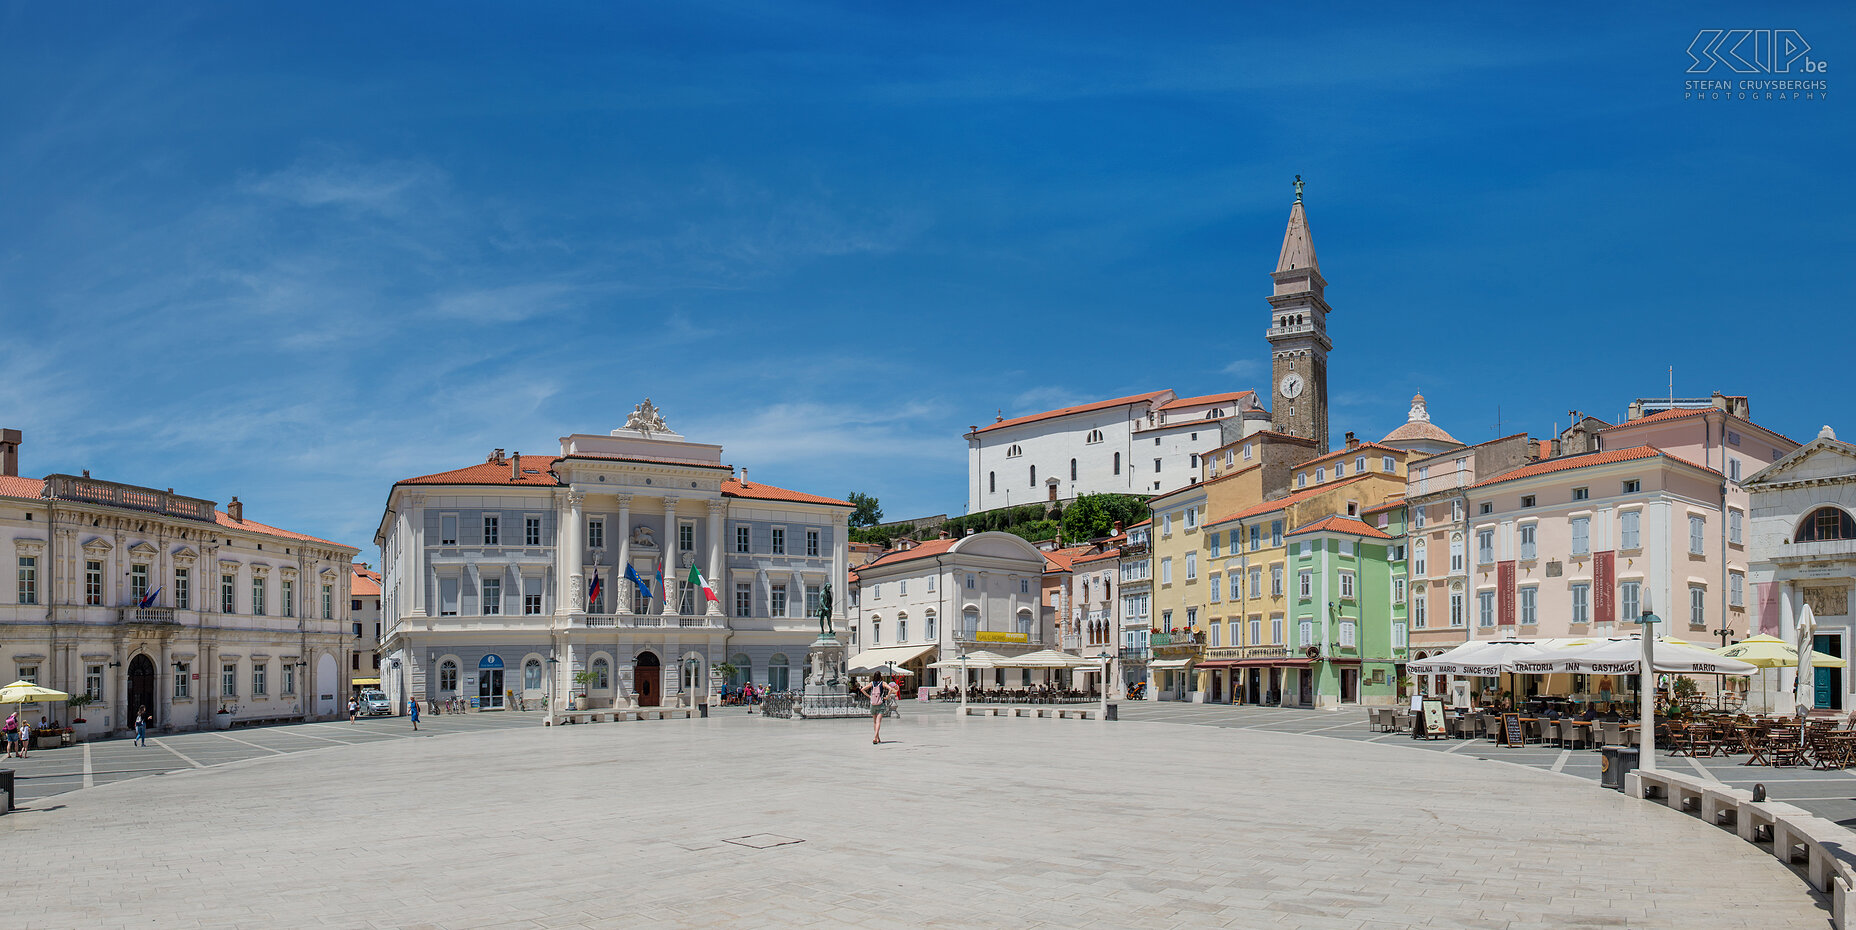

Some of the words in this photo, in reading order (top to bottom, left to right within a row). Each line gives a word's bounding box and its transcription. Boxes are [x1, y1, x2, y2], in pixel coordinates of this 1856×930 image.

[1515, 663, 1554, 672] TRATTORIA
[1565, 662, 1580, 670] INN
[1592, 664, 1635, 672] GASTHAUS
[1692, 664, 1716, 672] MARIO
